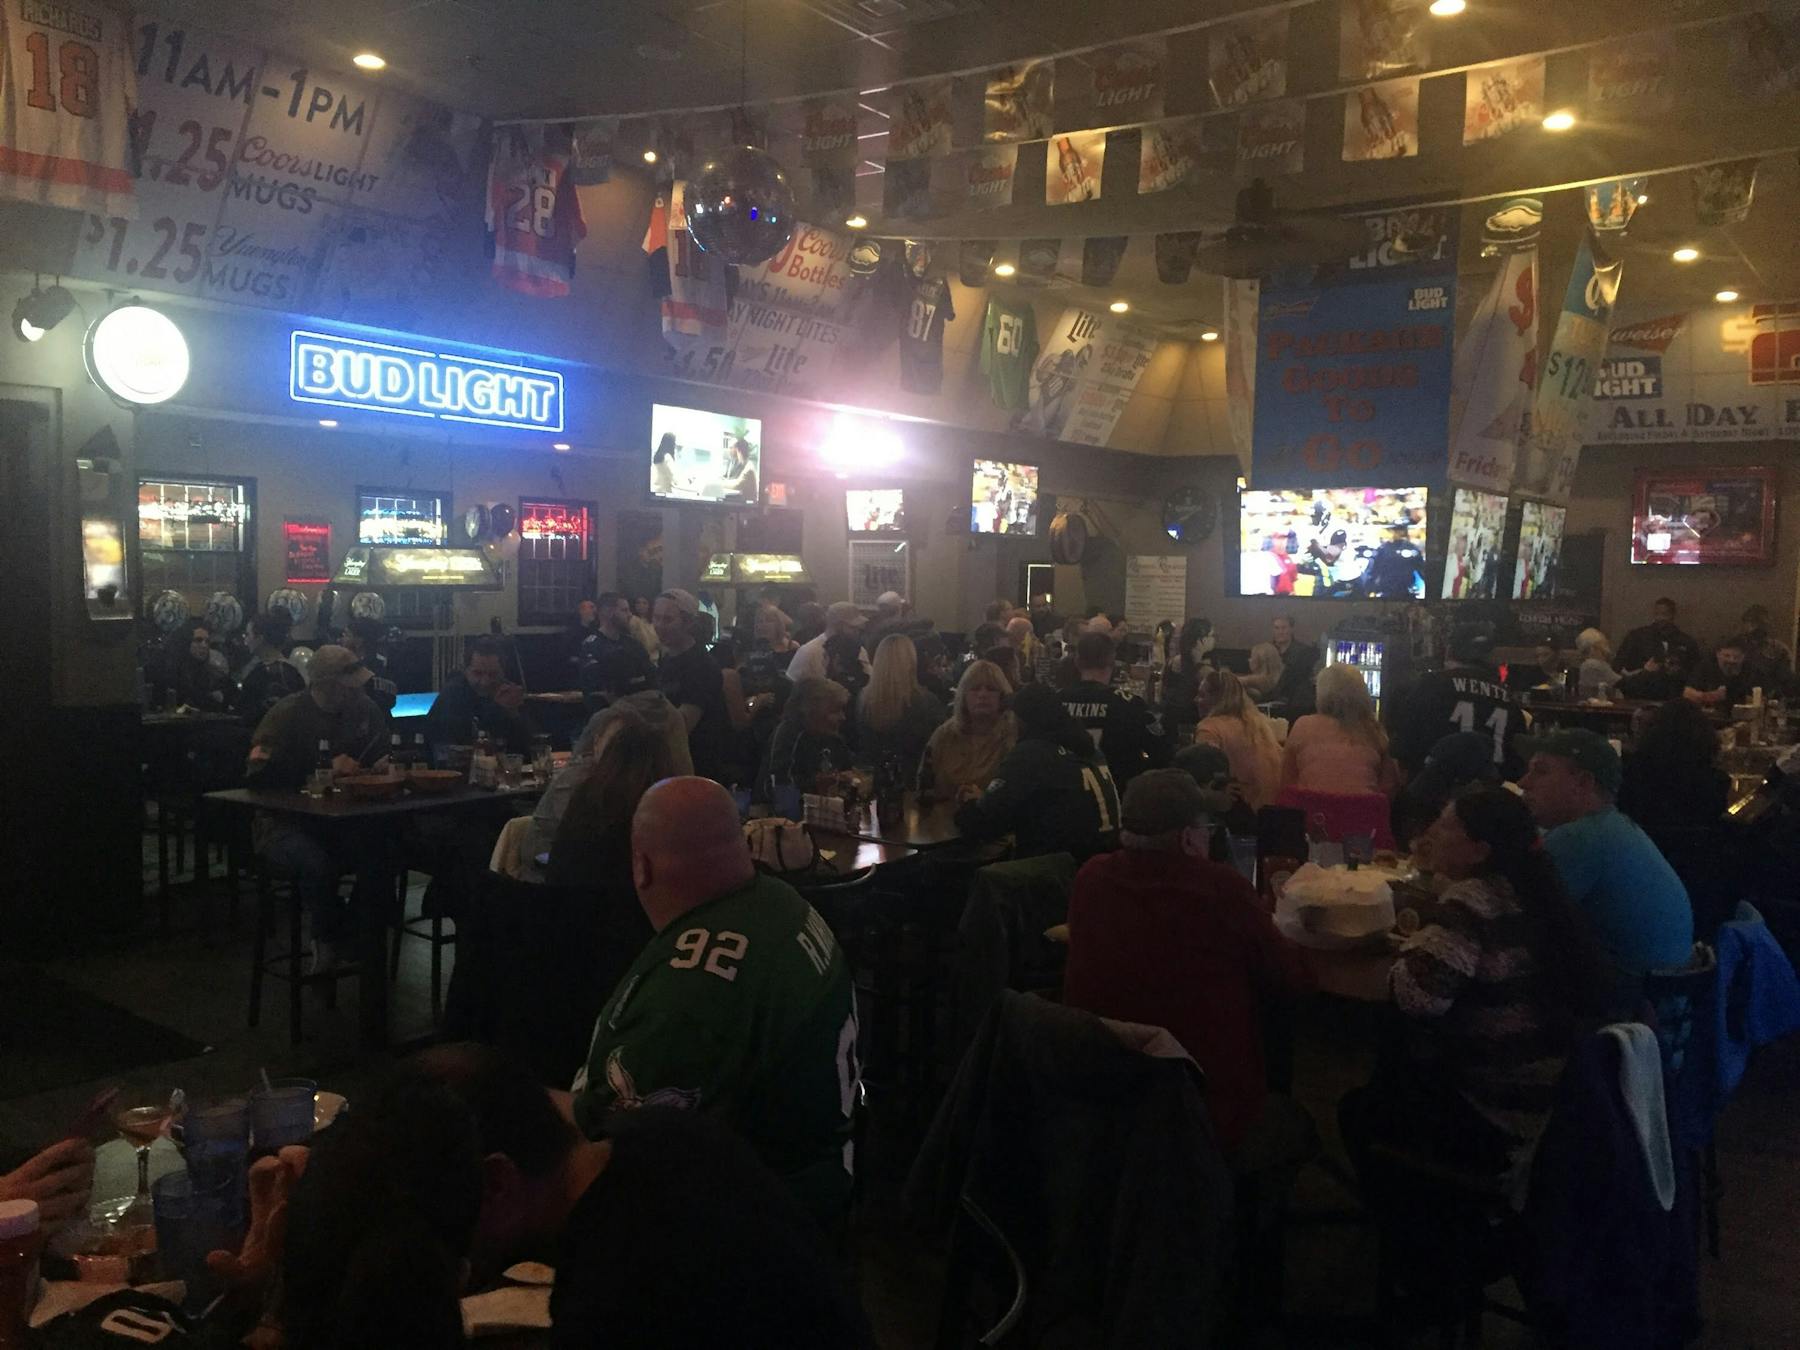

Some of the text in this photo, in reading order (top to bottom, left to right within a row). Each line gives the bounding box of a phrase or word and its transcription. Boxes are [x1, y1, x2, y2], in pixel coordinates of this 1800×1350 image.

[26, 31, 100, 119] 18
[229, 170, 318, 215] MUGS
[313, 161, 380, 193] LIGHT
[968, 178, 1008, 196] LIGHT
[506, 183, 557, 239] 28
[201, 257, 290, 299] MUGS
[786, 254, 846, 290] Bottles
[1407, 297, 1449, 311] LIGHT
[1413, 287, 1445, 300] BUD
[907, 299, 936, 342] 87
[996, 312, 1023, 358] 60
[299, 343, 555, 422] BUD LIGHT
[1593, 377, 1657, 397] IGHT
[1608, 404, 1674, 429] ALL
[1686, 402, 1761, 427] DAY
[1061, 701, 1109, 718] NKINS
[669, 927, 750, 983] 92
